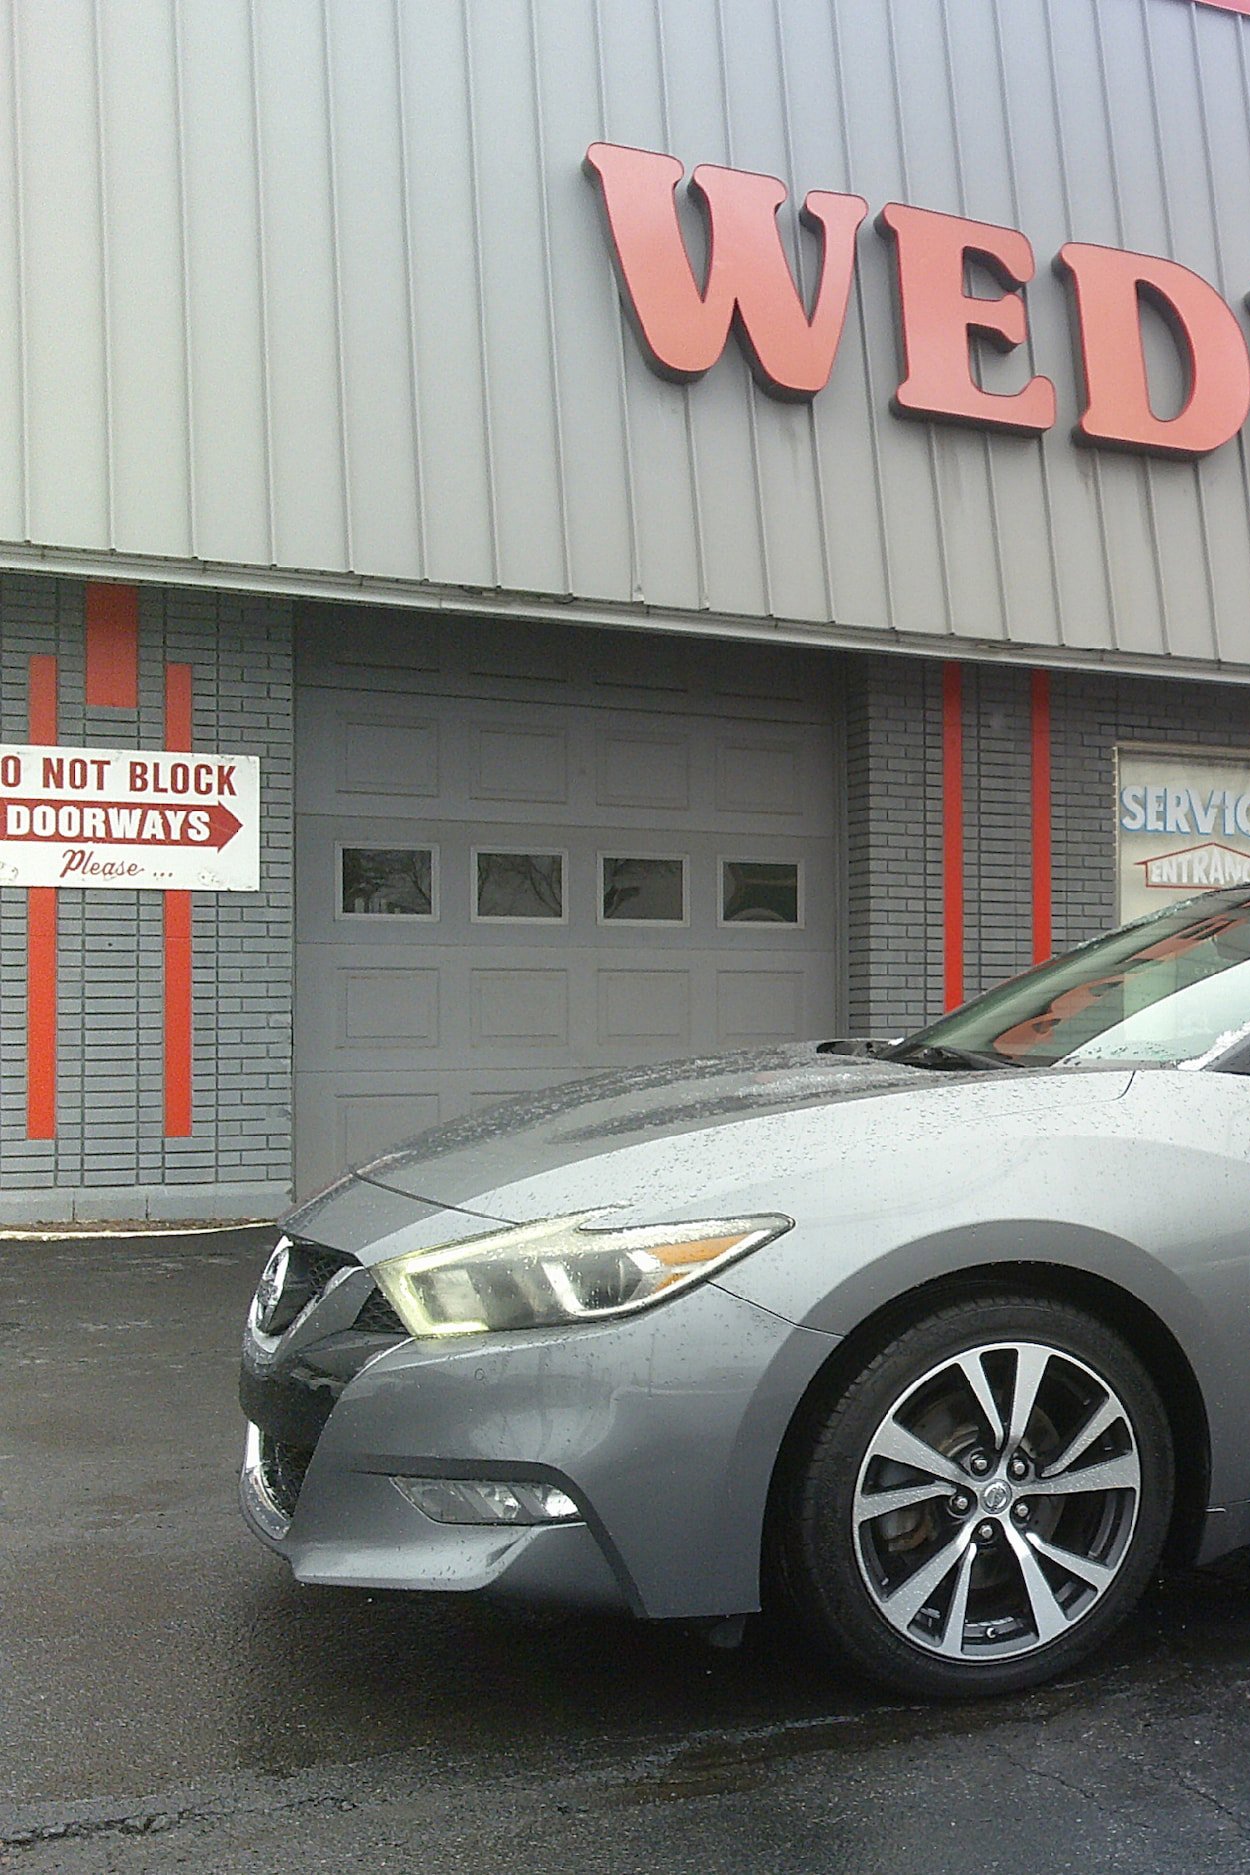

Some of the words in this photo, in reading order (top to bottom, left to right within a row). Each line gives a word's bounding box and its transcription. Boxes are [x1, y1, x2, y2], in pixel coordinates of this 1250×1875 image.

[42, 757, 111, 790] NOT
[129, 761, 237, 796] BLOCK
[6, 804, 210, 841] DOORWAYS
